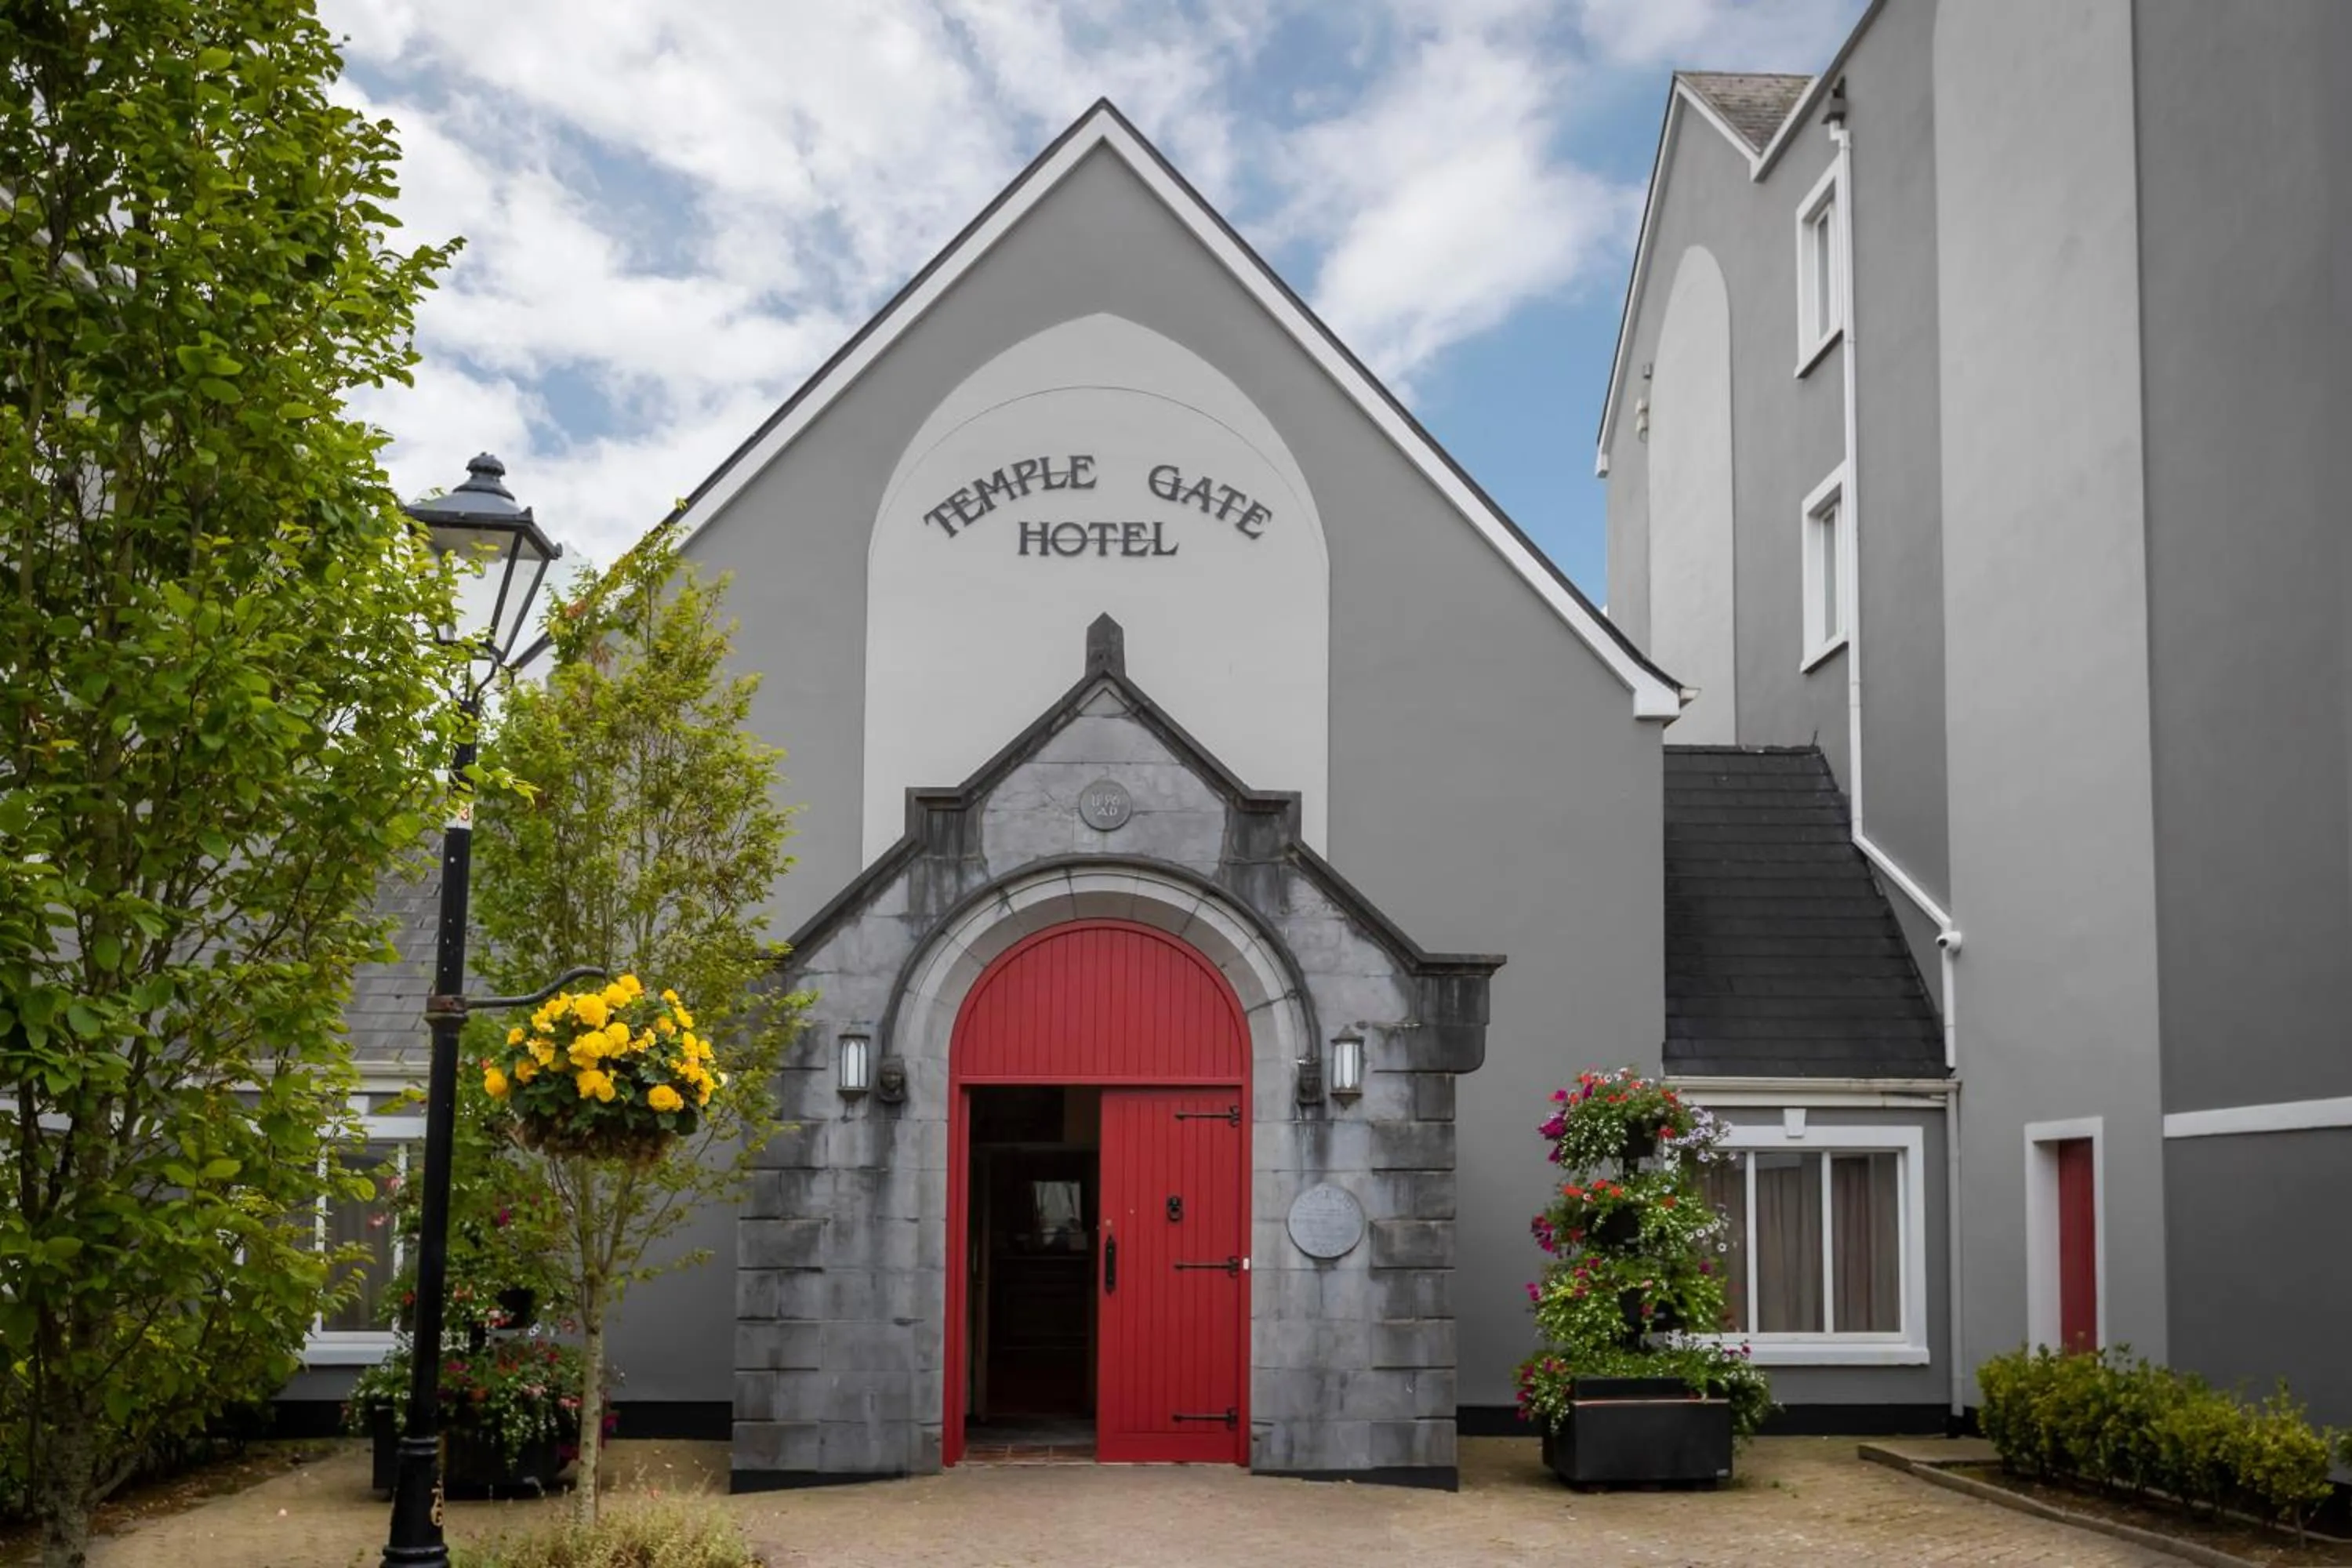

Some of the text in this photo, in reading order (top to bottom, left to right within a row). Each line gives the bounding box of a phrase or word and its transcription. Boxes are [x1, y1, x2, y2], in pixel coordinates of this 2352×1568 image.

[923, 455, 1272, 540] TEMPLE GATE
[1018, 521, 1179, 557] HOTEL
